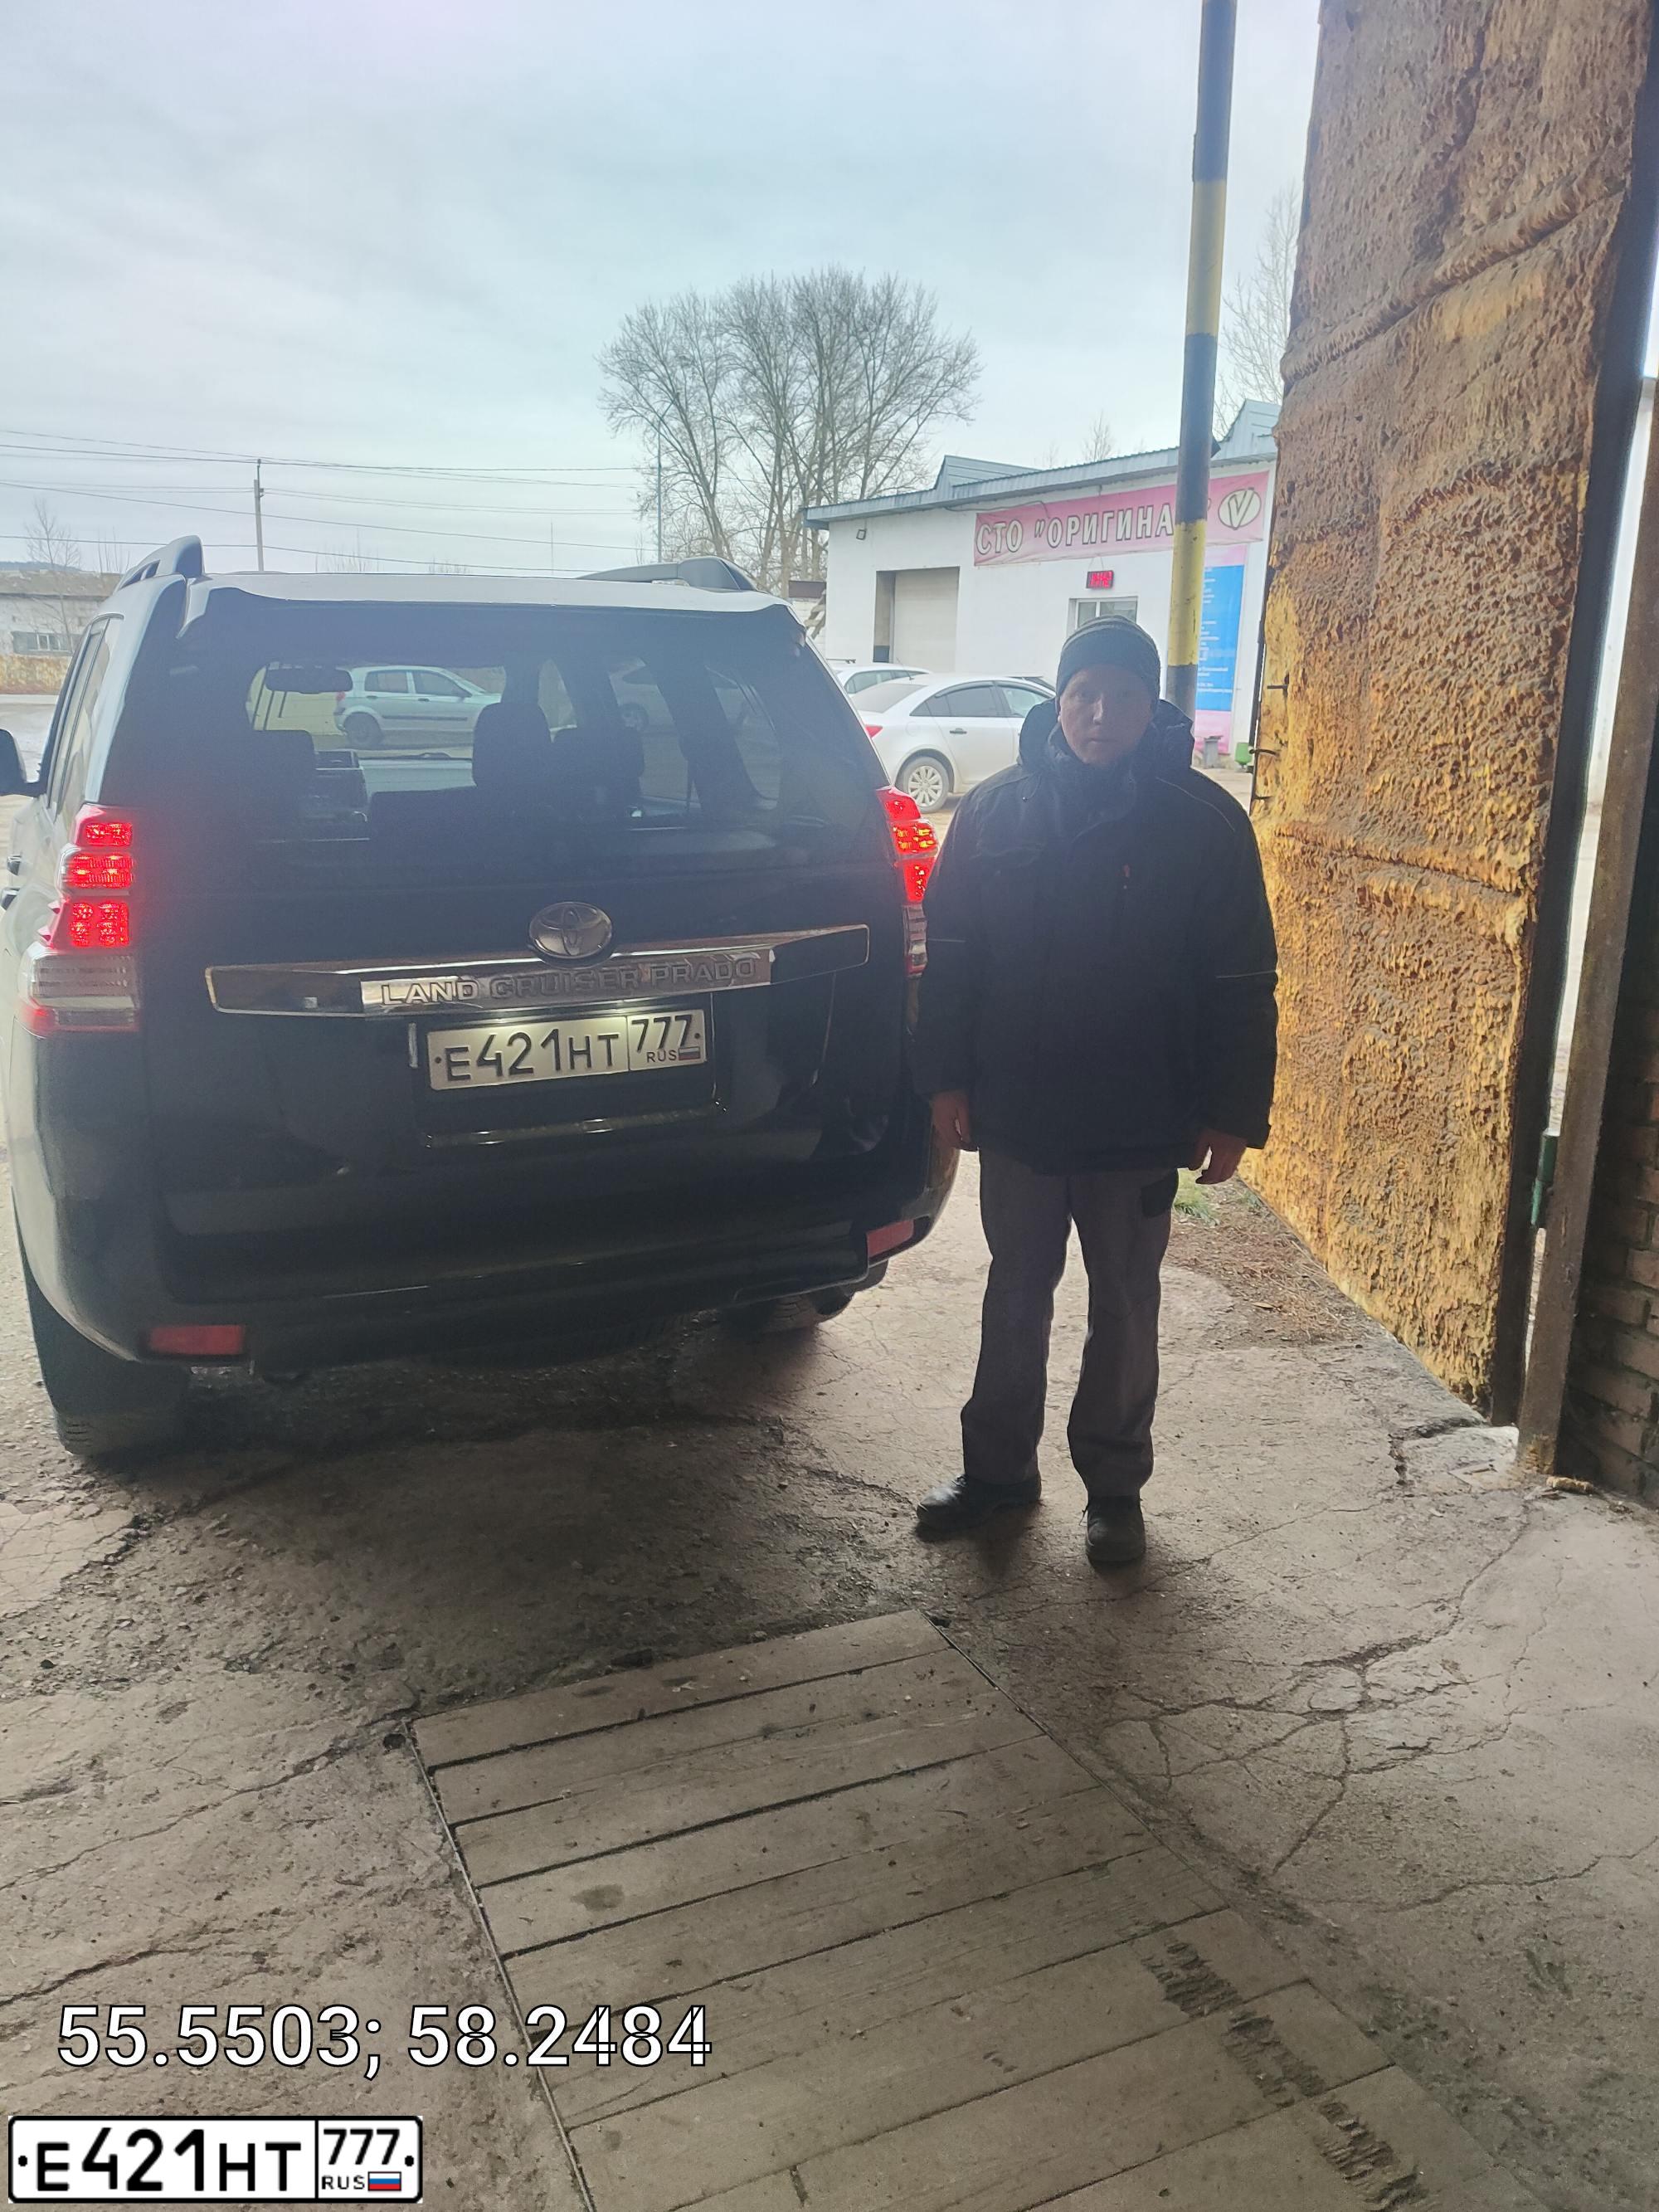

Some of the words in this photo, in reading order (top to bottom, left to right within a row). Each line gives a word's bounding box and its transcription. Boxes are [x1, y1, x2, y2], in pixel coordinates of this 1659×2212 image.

[976, 519, 1024, 554] СТО
[1034, 496, 1211, 548] "ОРИГИНА
[381, 980, 479, 1007] LAND
[490, 967, 642, 998] CRUISER
[651, 955, 757, 987] PRADO
[444, 1028, 620, 1082] Е421НТ
[631, 1014, 693, 1053] 777
[647, 1049, 677, 1063] RUS
